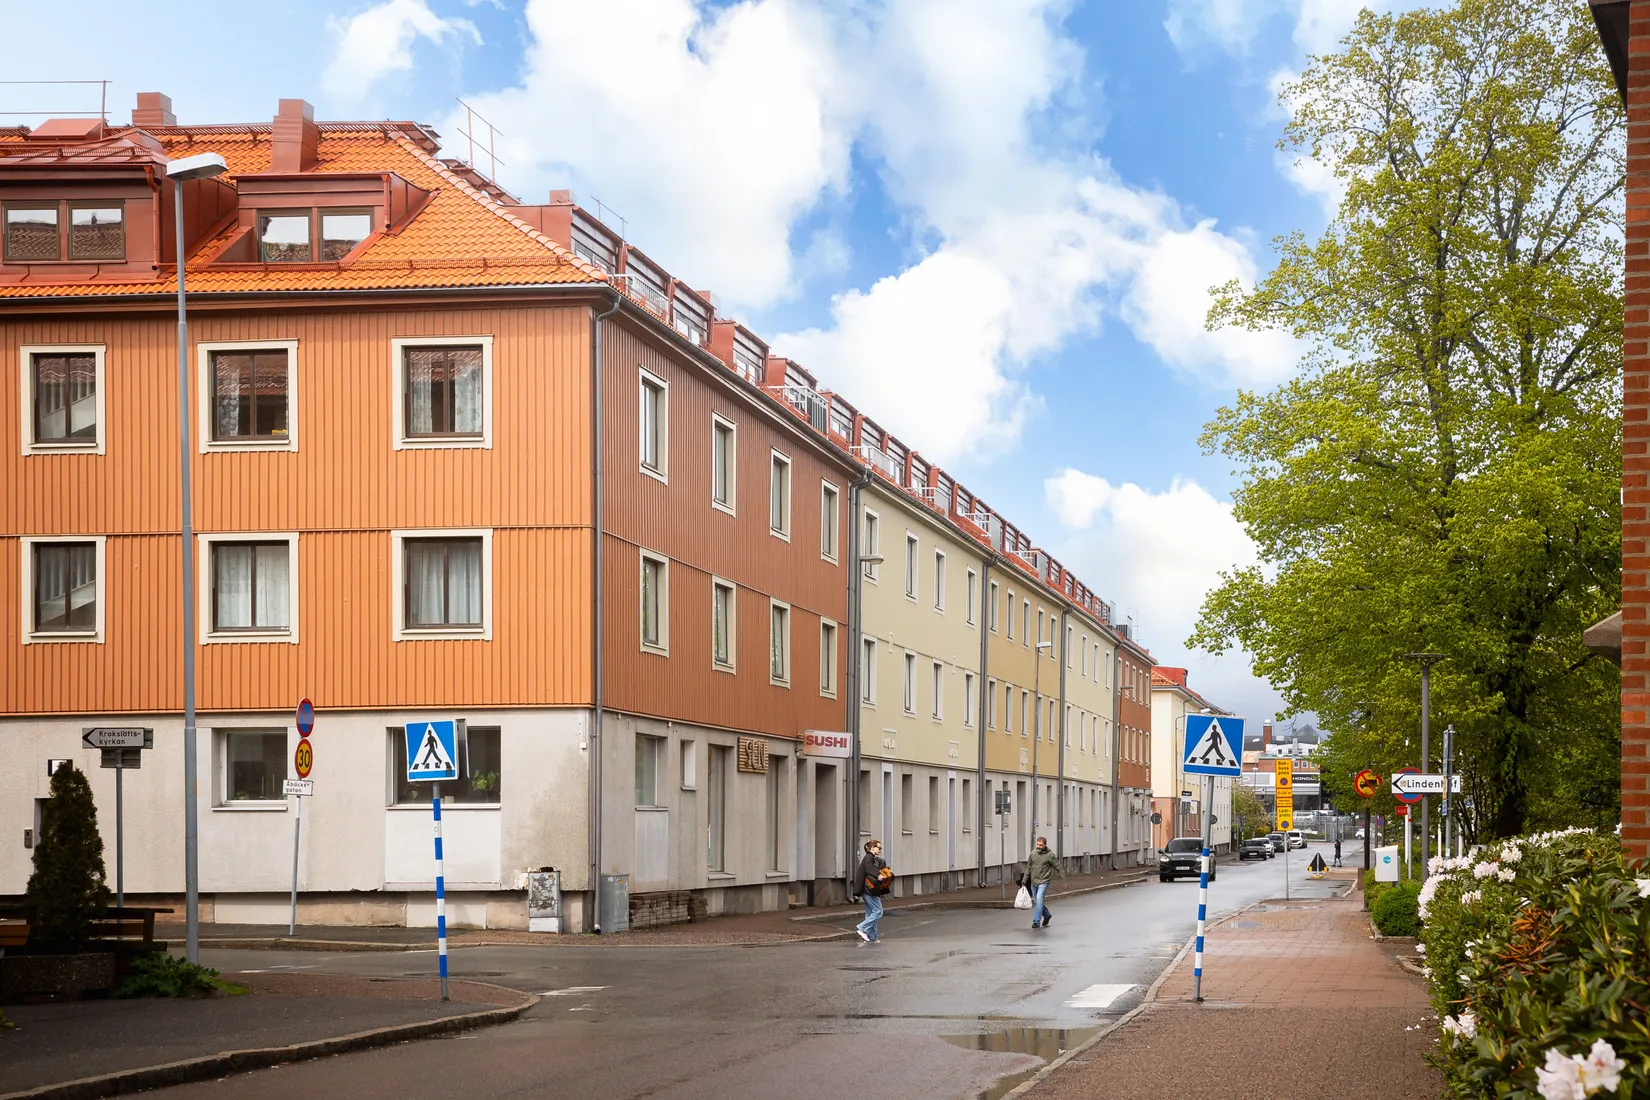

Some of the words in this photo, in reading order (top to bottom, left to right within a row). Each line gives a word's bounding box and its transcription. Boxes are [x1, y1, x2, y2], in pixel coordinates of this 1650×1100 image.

[99, 730, 141, 738] Krokslätts-
[805, 735, 848, 749] SUSHI
[299, 749, 311, 768] 30
[1407, 779, 1458, 788] Lindenhf
